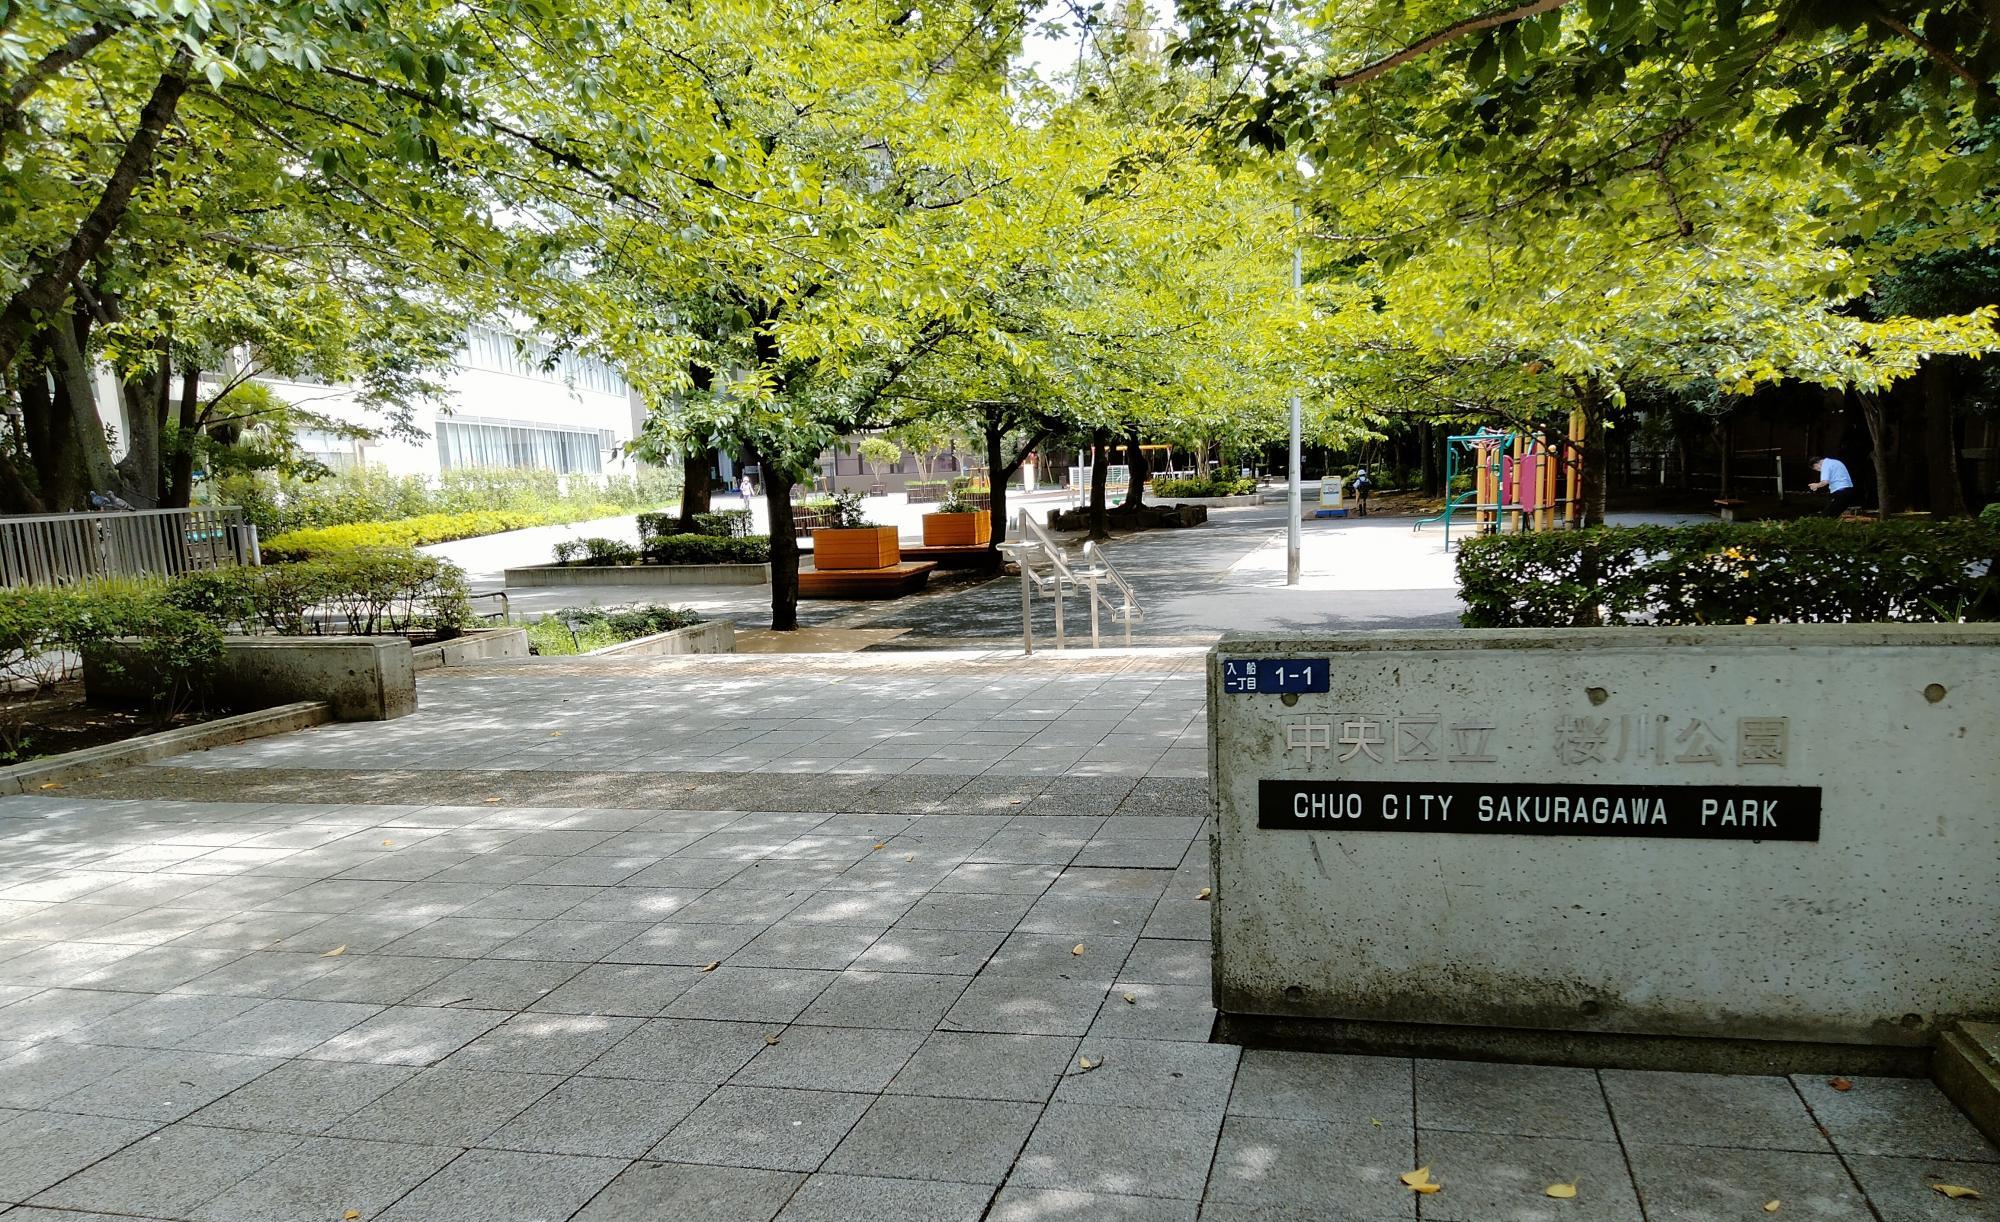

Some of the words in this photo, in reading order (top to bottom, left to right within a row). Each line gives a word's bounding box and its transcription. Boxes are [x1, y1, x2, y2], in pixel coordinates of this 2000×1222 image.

[1227, 677, 1257, 690] 一丁目
[1275, 666, 1312, 686] 1-1
[1286, 716, 1498, 764] 中央区立
[1553, 714, 1791, 768] 桜川公園
[1293, 792, 1362, 819] CHUO
[1382, 794, 1453, 821] CITY
[1478, 796, 1668, 825] SAKURAGAWA
[1701, 799, 1778, 827] PARK
